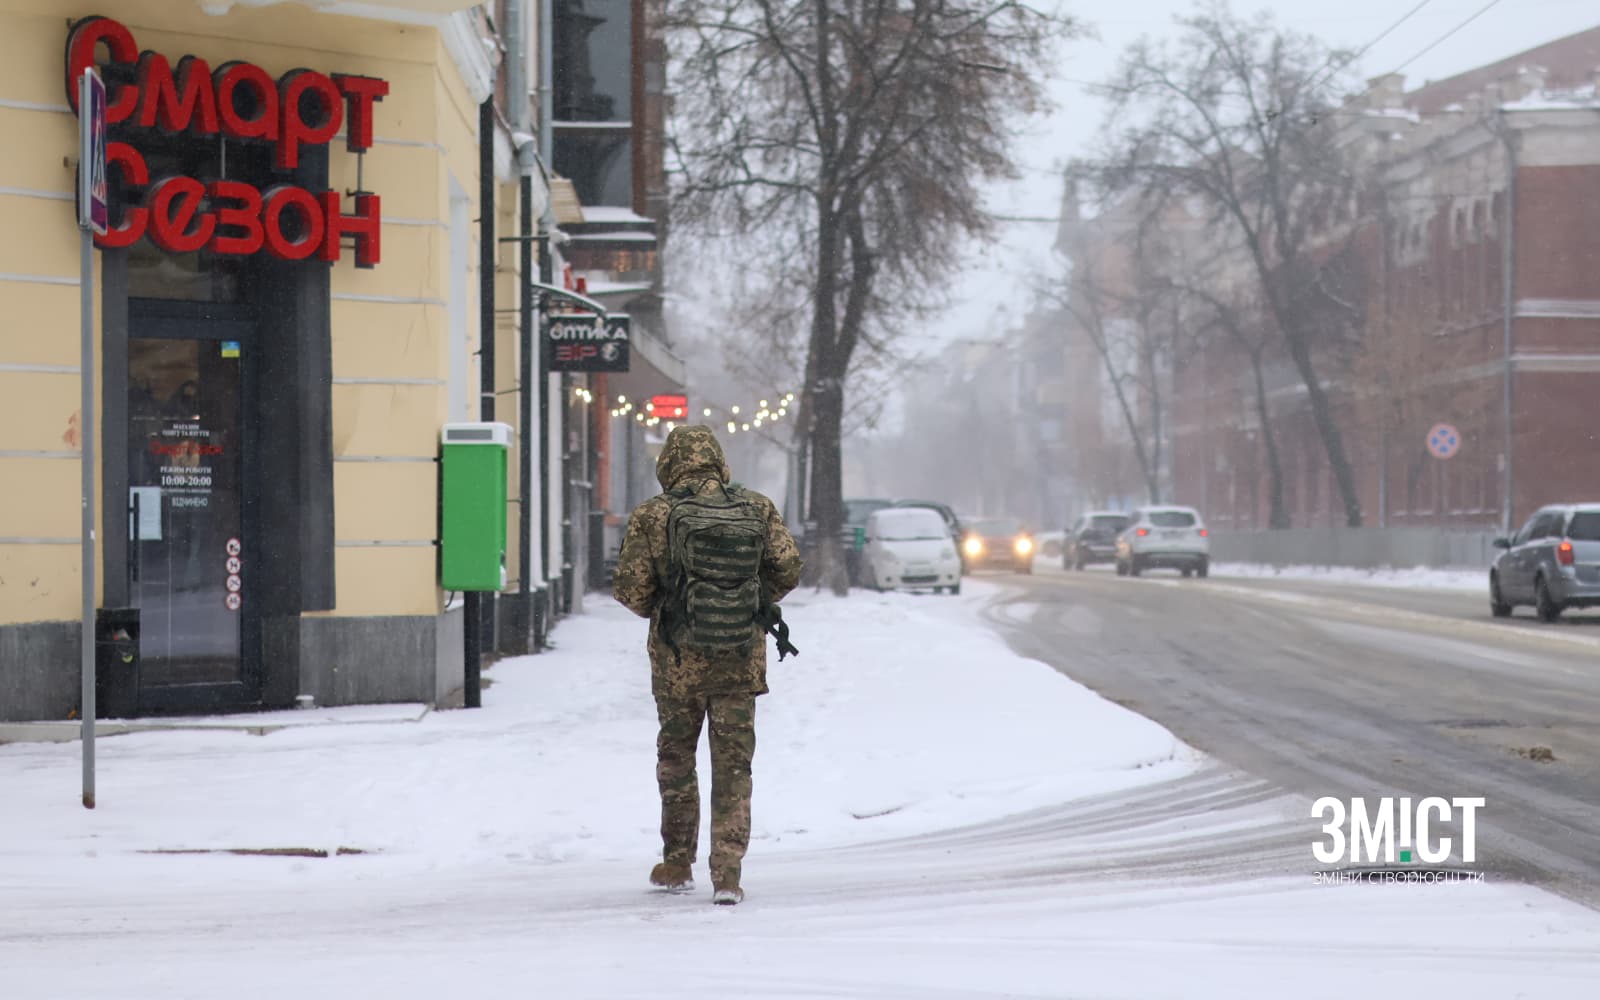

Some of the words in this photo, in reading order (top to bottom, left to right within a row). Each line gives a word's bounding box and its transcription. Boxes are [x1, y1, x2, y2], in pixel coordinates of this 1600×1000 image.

[66, 16, 389, 168] Смарт
[77, 142, 381, 268] Сезон
[161, 475, 212, 486] 10:00-20:00
